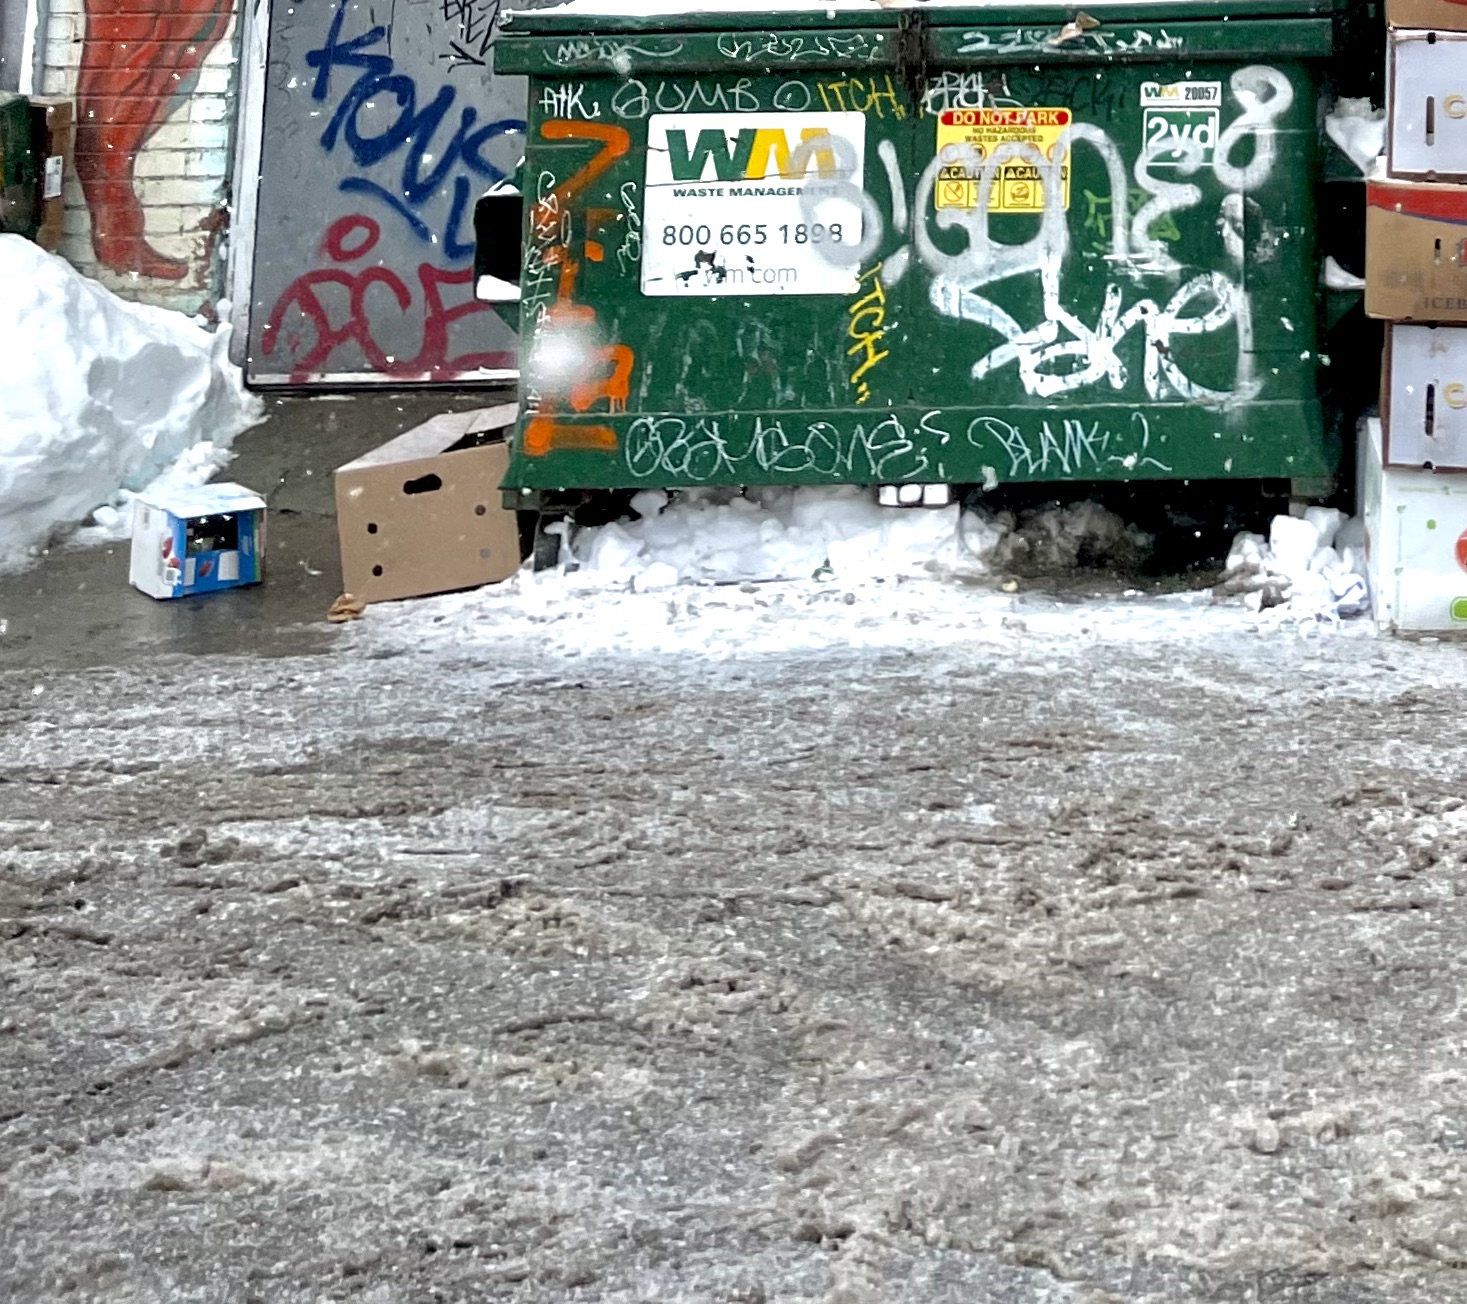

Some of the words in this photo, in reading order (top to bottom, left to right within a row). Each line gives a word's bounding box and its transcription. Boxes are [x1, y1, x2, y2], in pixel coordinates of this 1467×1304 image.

[1144, 86, 1180, 98] WM
[1185, 86, 1218, 101] 20057
[952, 110, 975, 125] DO
[979, 110, 1011, 125] NOT
[1015, 110, 1059, 125] PARK
[1147, 115, 1216, 158] 2yd
[665, 127, 838, 181] WM
[673, 187, 724, 197] WASTE
[662, 224, 711, 245] 800
[720, 223, 767, 245] 665
[778, 223, 843, 245] 1898
